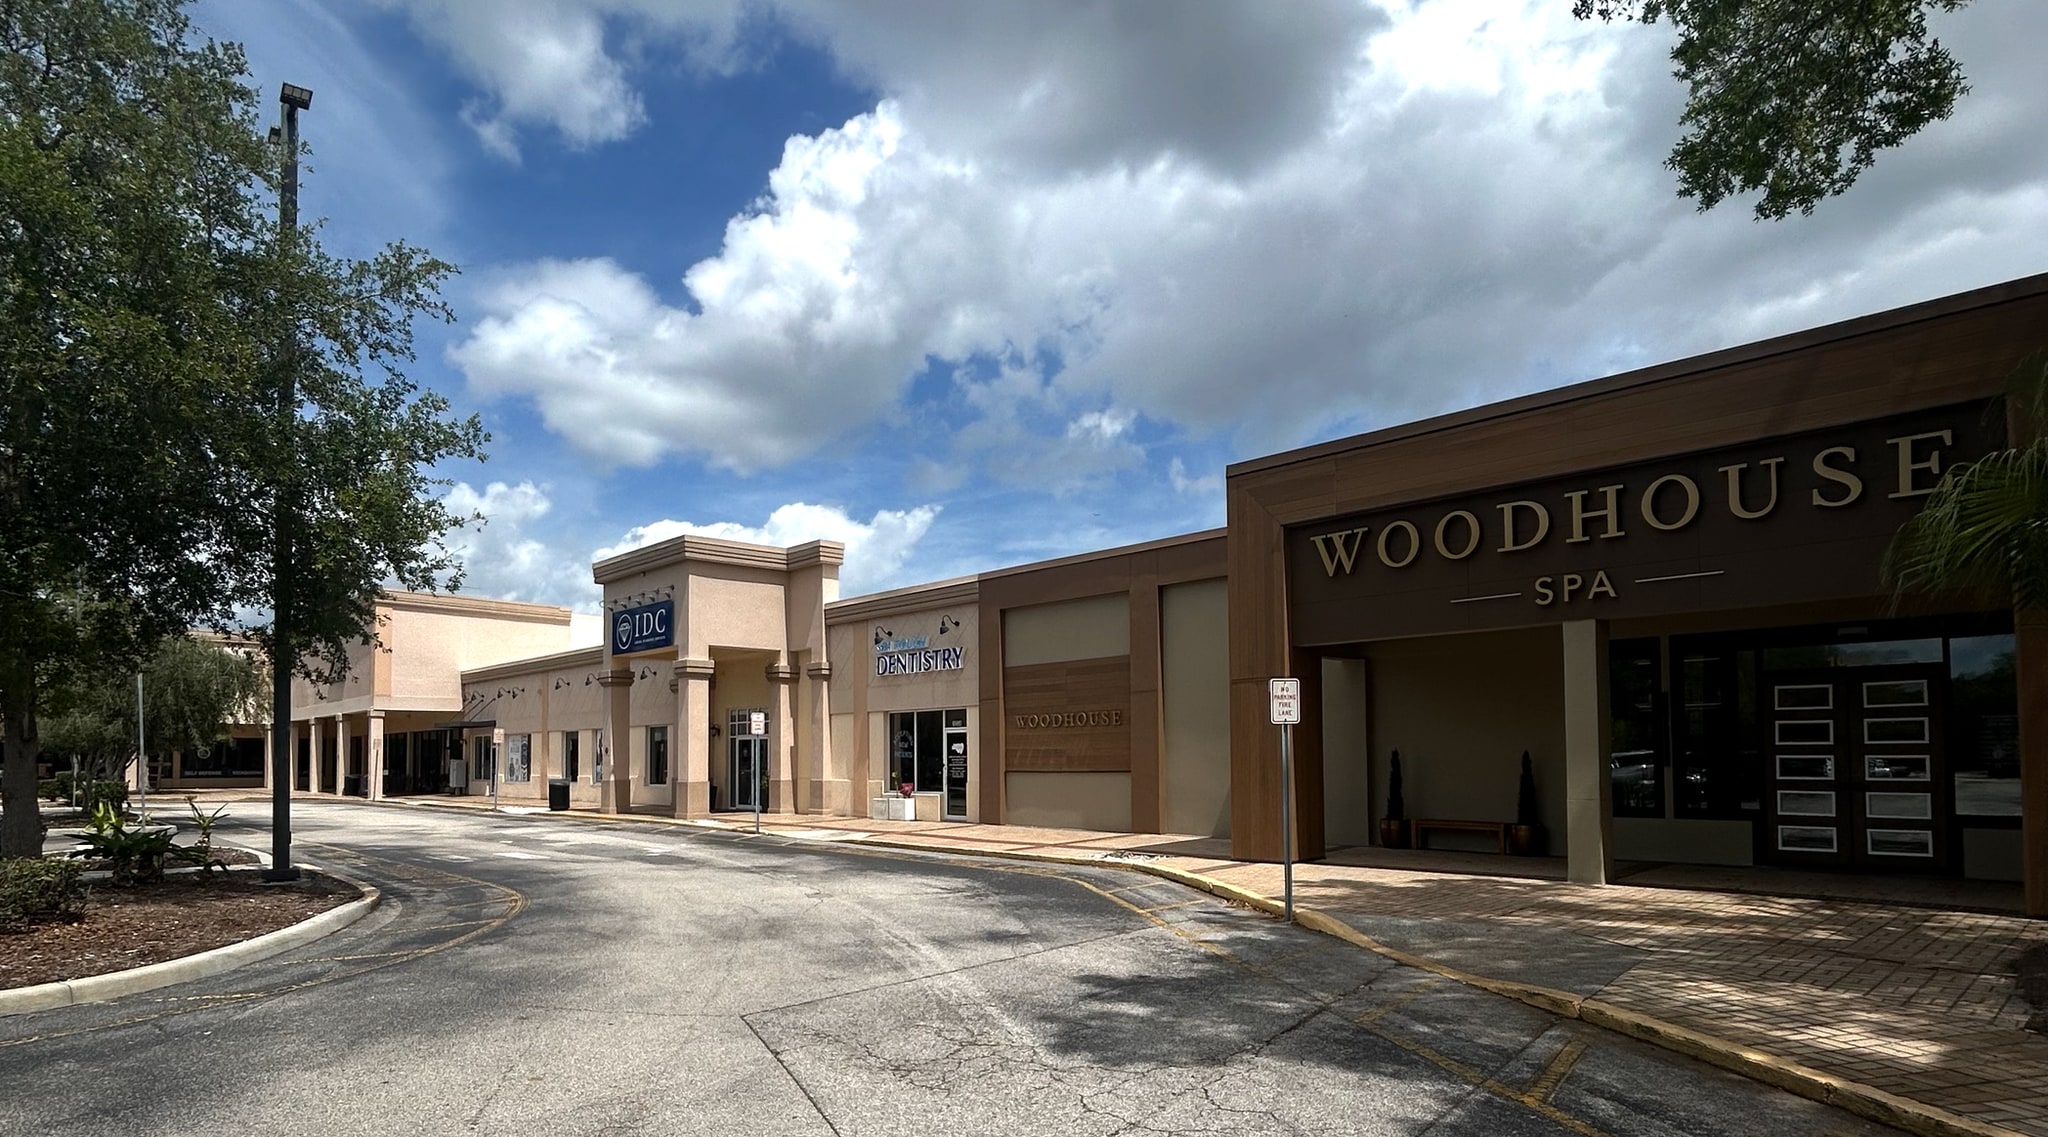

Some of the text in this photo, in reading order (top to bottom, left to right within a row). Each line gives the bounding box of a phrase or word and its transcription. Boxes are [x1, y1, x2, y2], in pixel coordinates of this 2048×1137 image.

[1311, 429, 1954, 577] WOODHOUSE
[1534, 570, 1618, 606] SPA
[634, 609, 666, 637] IDC
[877, 647, 963, 676] DENTISTRY
[1015, 710, 1121, 729] WOODHOUSE
